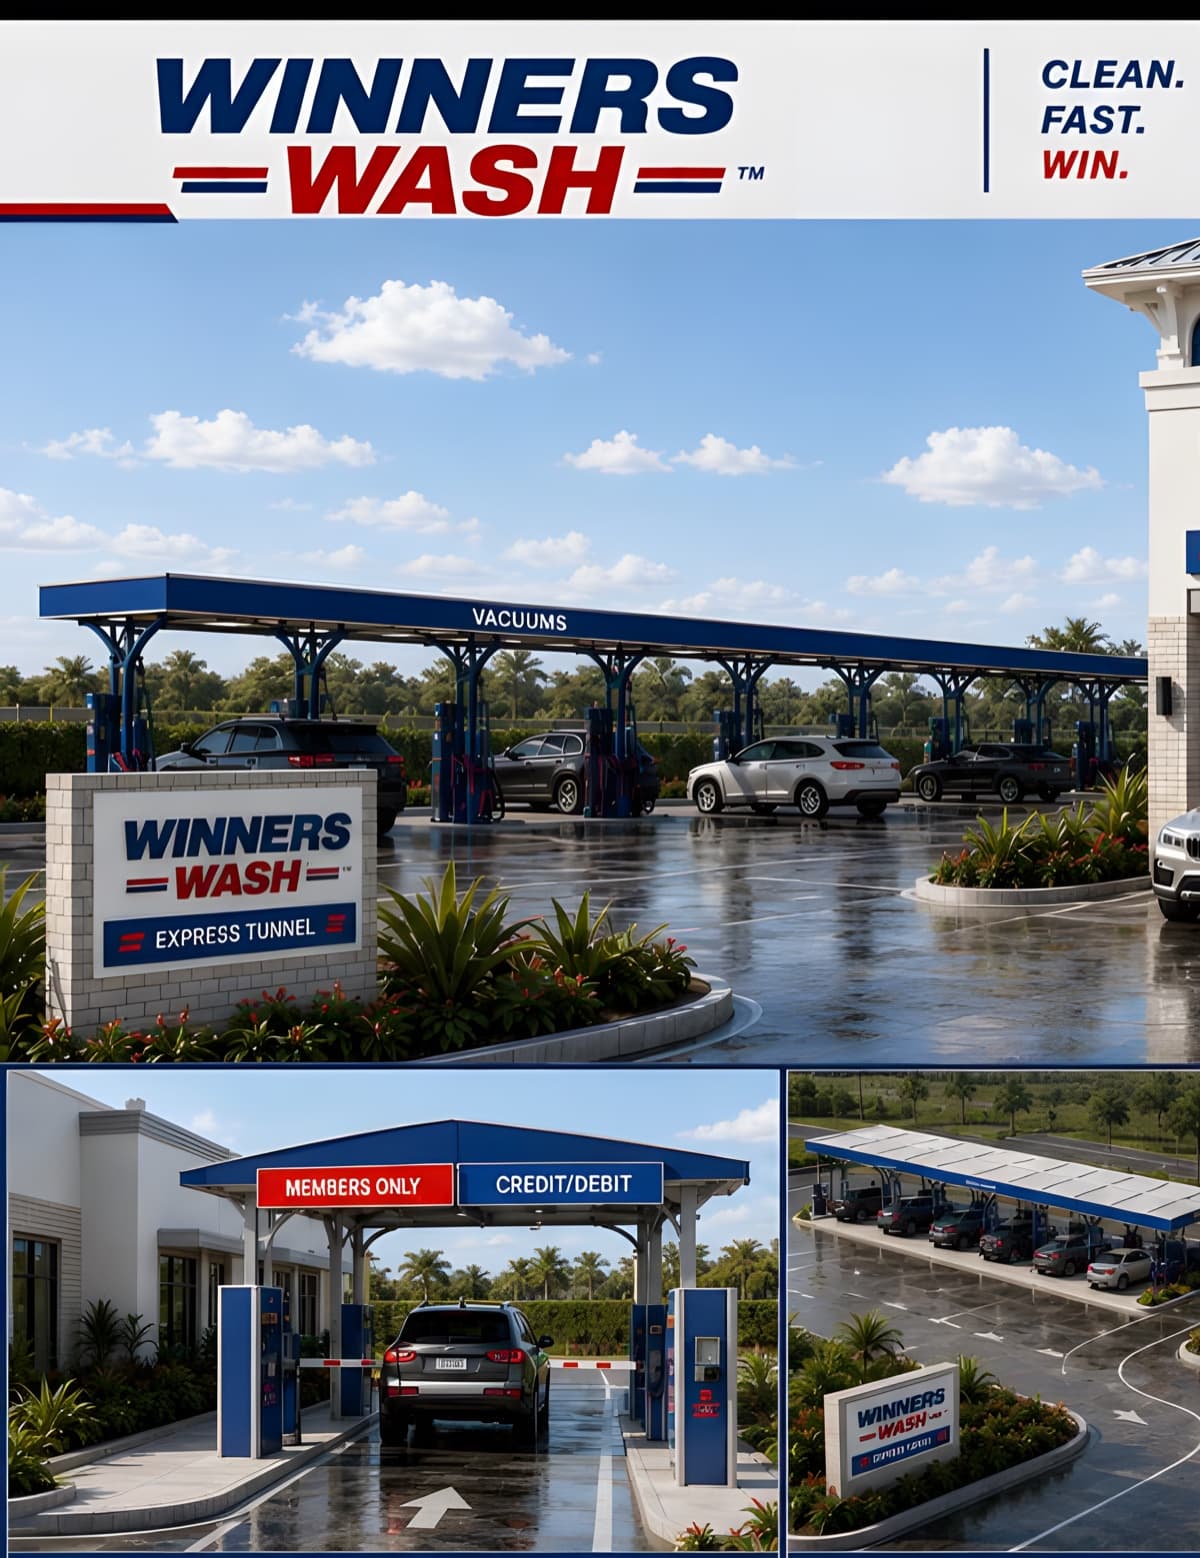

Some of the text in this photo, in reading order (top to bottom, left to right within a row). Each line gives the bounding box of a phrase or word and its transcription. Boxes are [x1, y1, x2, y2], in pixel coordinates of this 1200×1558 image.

[472, 607, 567, 631] VACUUMS
[124, 812, 352, 860] WINNERS
[175, 859, 302, 900] WASH
[156, 918, 316, 949] EXPRESS TUNNEL
[286, 1177, 421, 1197] MEMBERS ONLY
[496, 1174, 632, 1194] CREDIT/DEBIT
[858, 1388, 945, 1428] WINNERS
[878, 1411, 927, 1440] WASH
